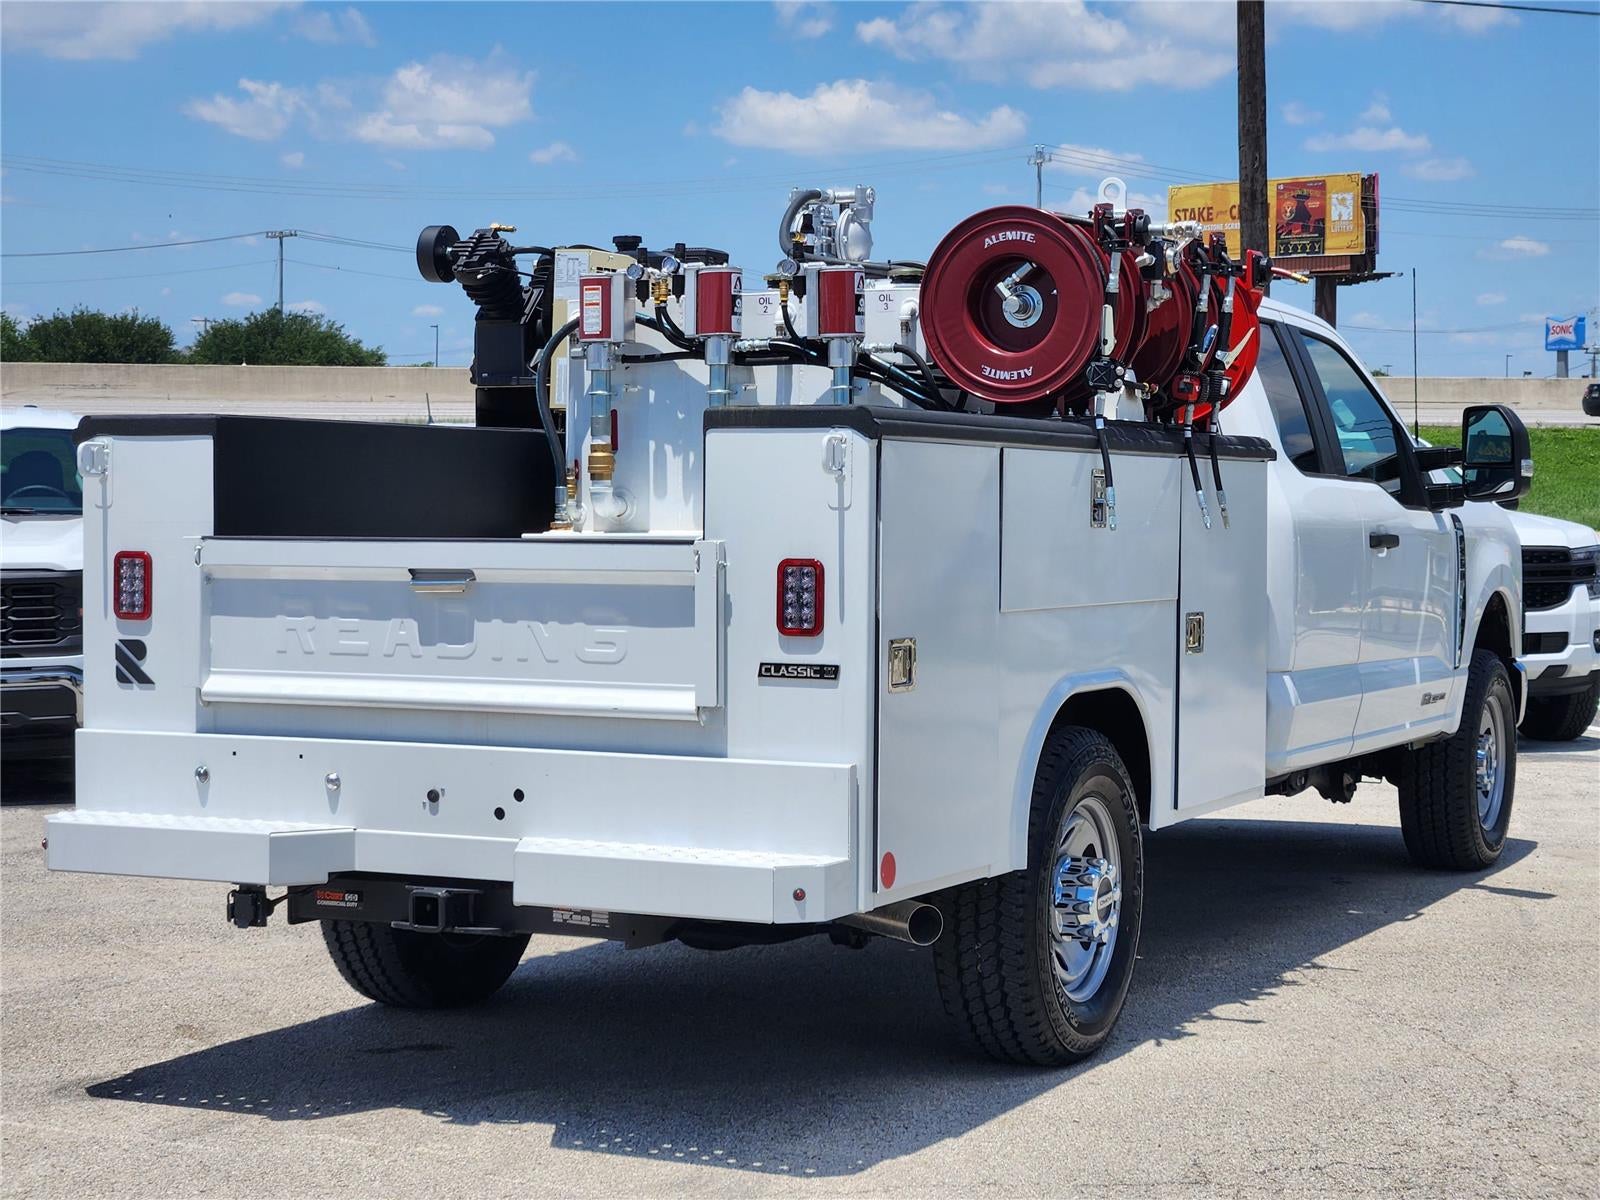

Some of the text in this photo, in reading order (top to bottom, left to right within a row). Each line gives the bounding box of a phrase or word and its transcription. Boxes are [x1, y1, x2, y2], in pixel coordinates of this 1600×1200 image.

[1174, 207, 1214, 222] STAKE
[984, 231, 1036, 249] ALEMITE
[758, 296, 773, 305] OIL
[879, 294, 893, 302] OIL
[763, 305, 768, 313] 2
[1551, 324, 1573, 335] SONIC
[981, 365, 1034, 380] ALEMITE
[761, 664, 820, 678] CLASSIC
